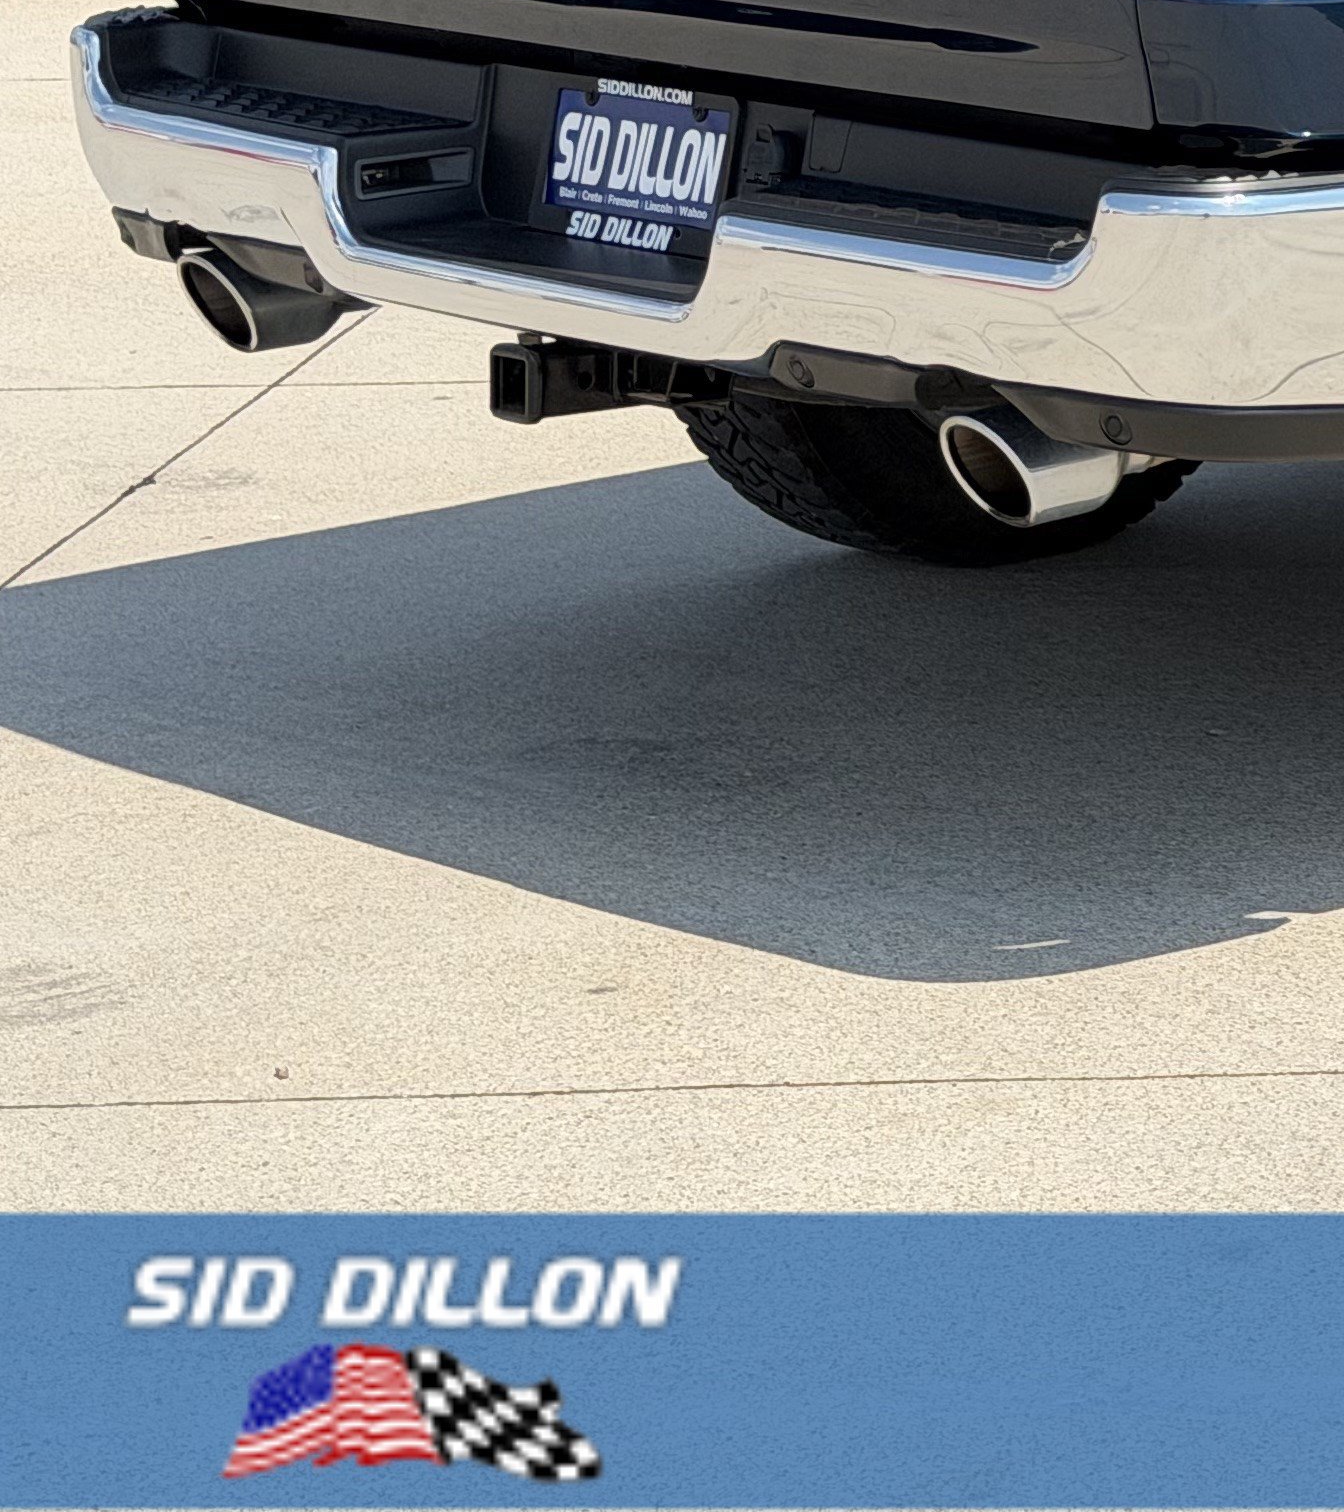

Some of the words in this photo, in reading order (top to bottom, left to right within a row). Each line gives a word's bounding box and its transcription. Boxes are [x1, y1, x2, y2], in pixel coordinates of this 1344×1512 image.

[597, 78, 694, 106] SIDDILLON.COM
[552, 112, 611, 186] SID
[607, 119, 727, 205] DILLON
[607, 193, 640, 210] Fremont
[644, 199, 674, 215] Lincoln
[565, 210, 602, 239] SID
[601, 216, 674, 252] DILLON
